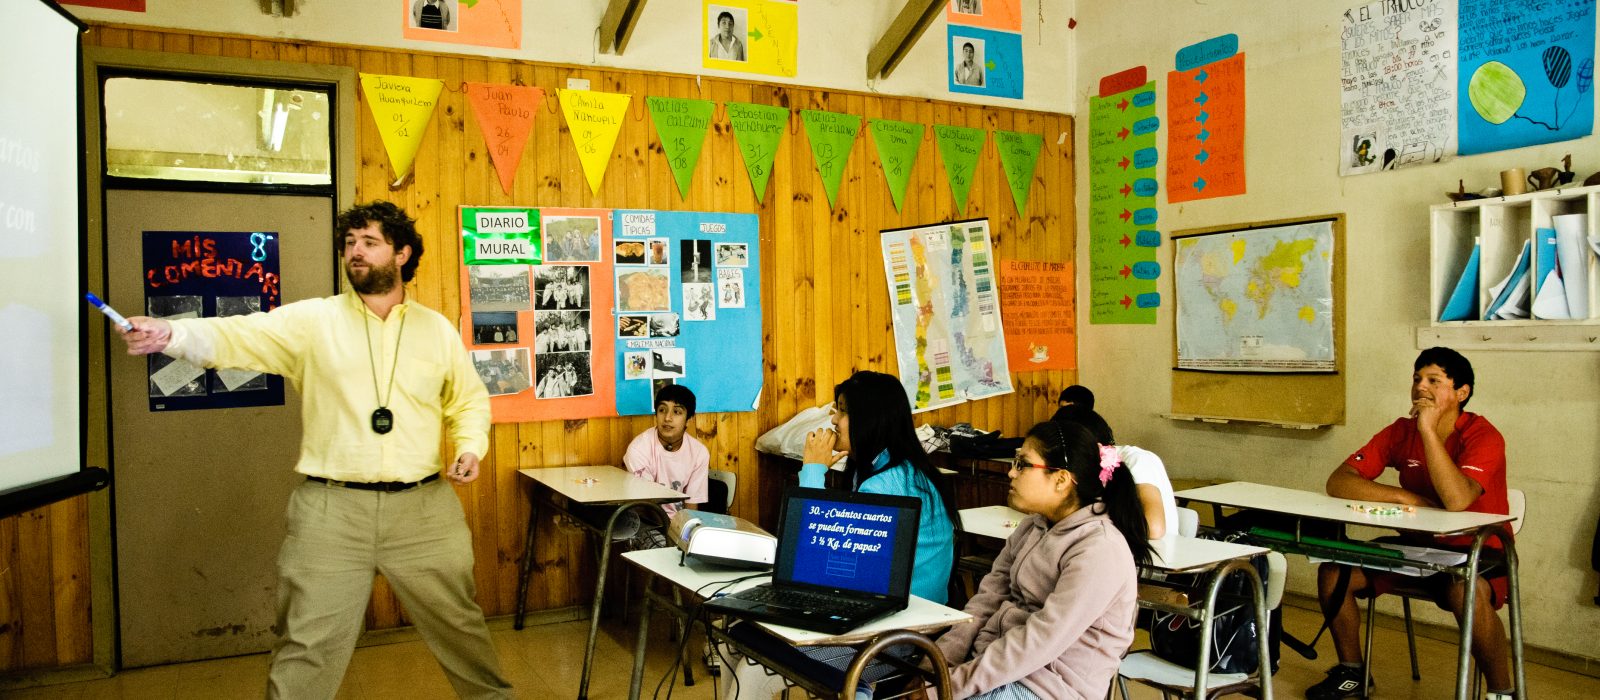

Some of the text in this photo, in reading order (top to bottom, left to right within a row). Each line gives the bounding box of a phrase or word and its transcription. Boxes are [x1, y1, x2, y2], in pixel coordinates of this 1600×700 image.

[1359, 5, 1371, 22] EL
[482, 86, 513, 101] Juan
[495, 126, 510, 138] 26
[497, 145, 509, 157] 04
[673, 137, 686, 151] 15
[747, 143, 762, 159] 31
[816, 142, 833, 159] 03
[674, 157, 688, 170] 08
[752, 164, 764, 179] 08
[7, 205, 35, 233] con
[480, 216, 525, 229] DIARIO
[624, 213, 655, 224] COMIDAS
[701, 223, 726, 233] JUEGOS
[480, 242, 526, 255] MURAL
[862, 512, 893, 523] cuartos
[808, 521, 888, 538] se pueden formar con
[811, 535, 817, 545] 3
[827, 537, 841, 550] Kg.
[842, 538, 852, 549] de
[852, 543, 882, 554] papas?
